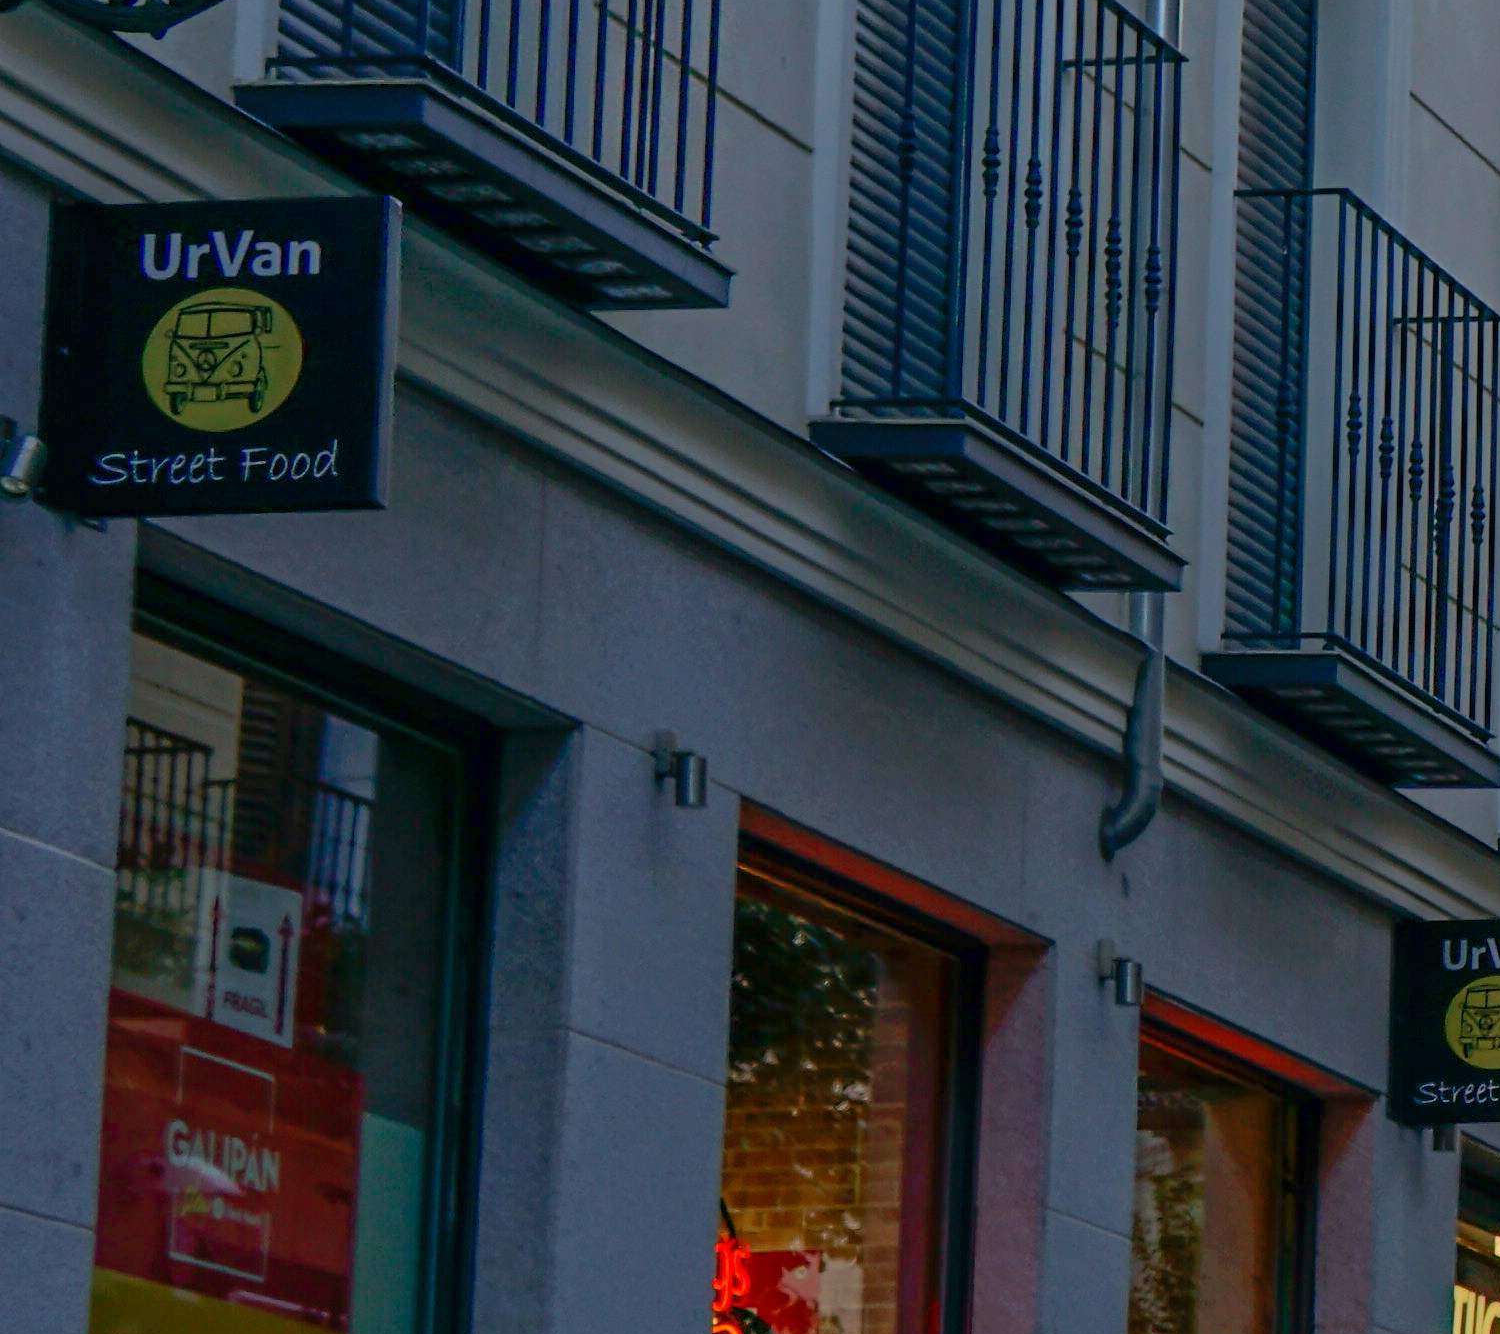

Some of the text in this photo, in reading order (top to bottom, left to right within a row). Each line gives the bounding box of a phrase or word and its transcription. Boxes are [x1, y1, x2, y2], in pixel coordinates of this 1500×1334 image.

[140, 229, 322, 280] UrVan
[92, 439, 339, 485] Street Food
[1416, 1078, 1499, 1105] Street
